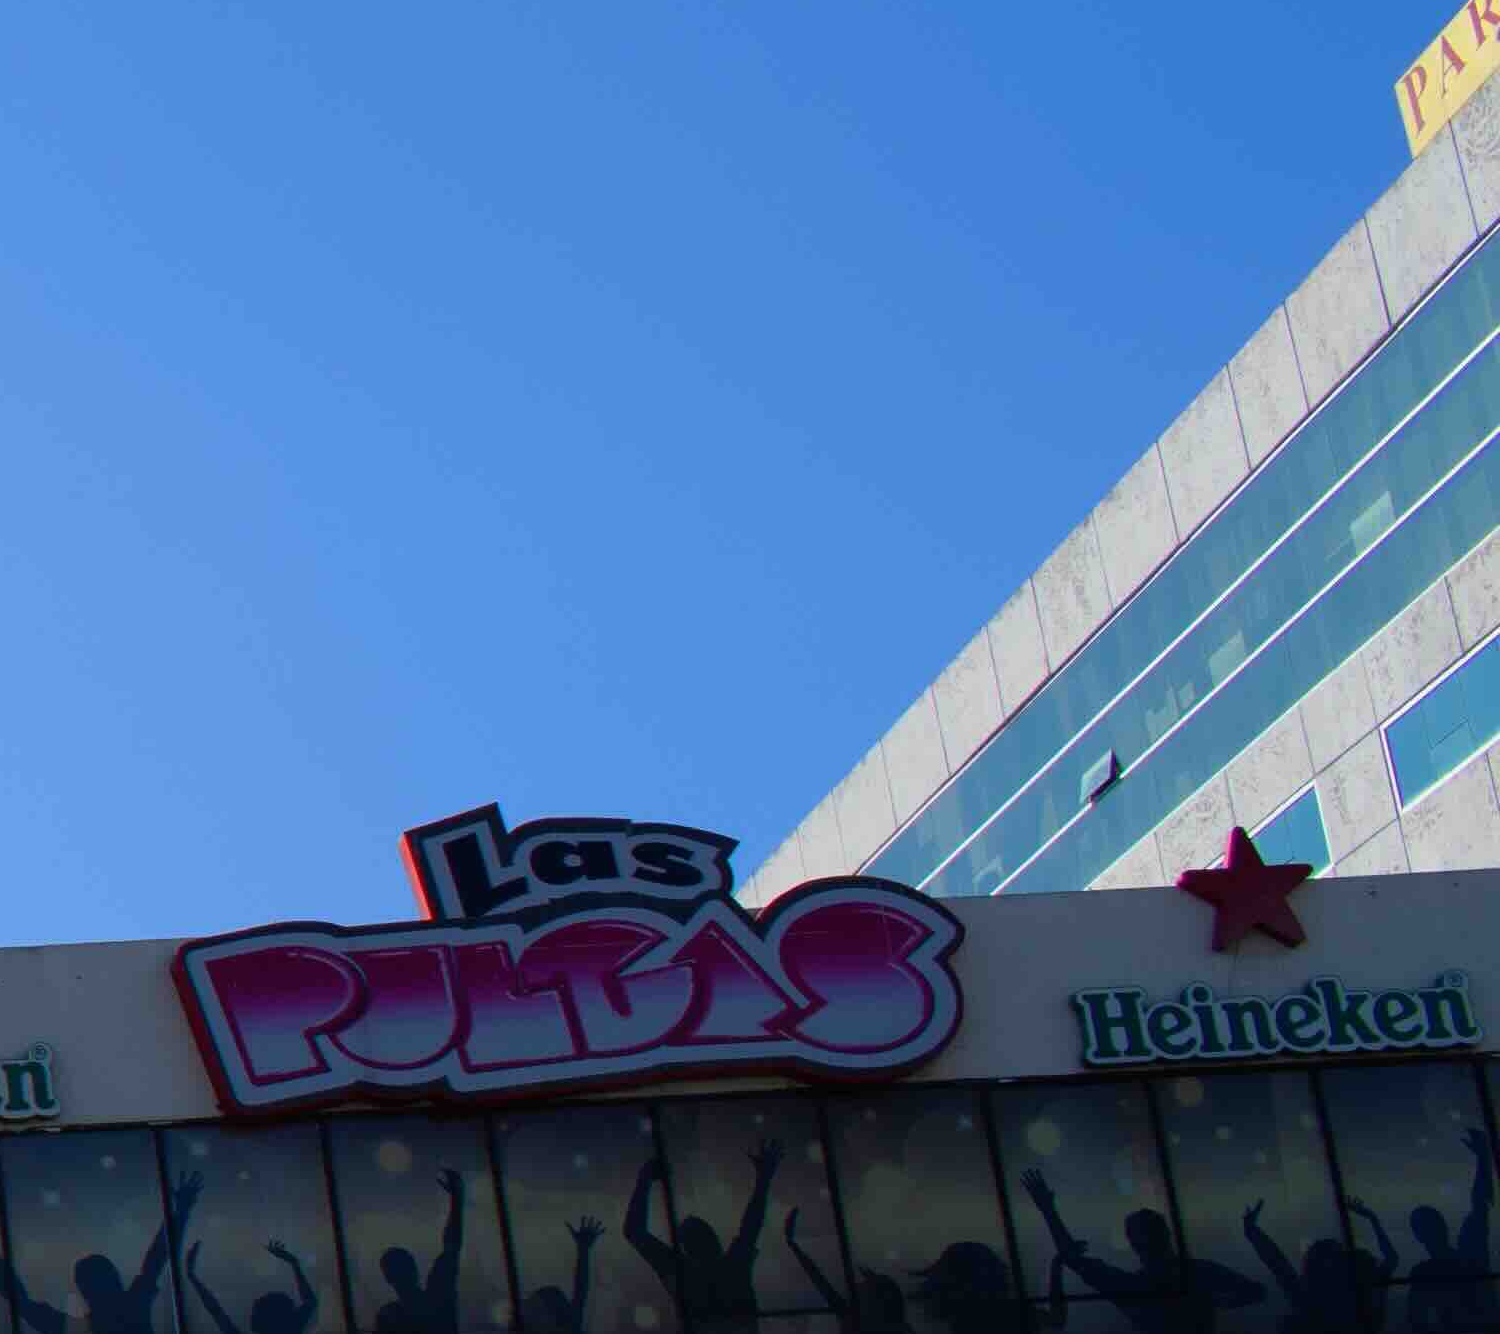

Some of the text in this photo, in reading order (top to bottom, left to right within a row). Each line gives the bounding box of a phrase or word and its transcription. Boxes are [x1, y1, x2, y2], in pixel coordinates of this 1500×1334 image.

[442, 831, 707, 910] Las
[204, 899, 938, 1086] PULGAS
[1080, 978, 1480, 1060] Heineken
